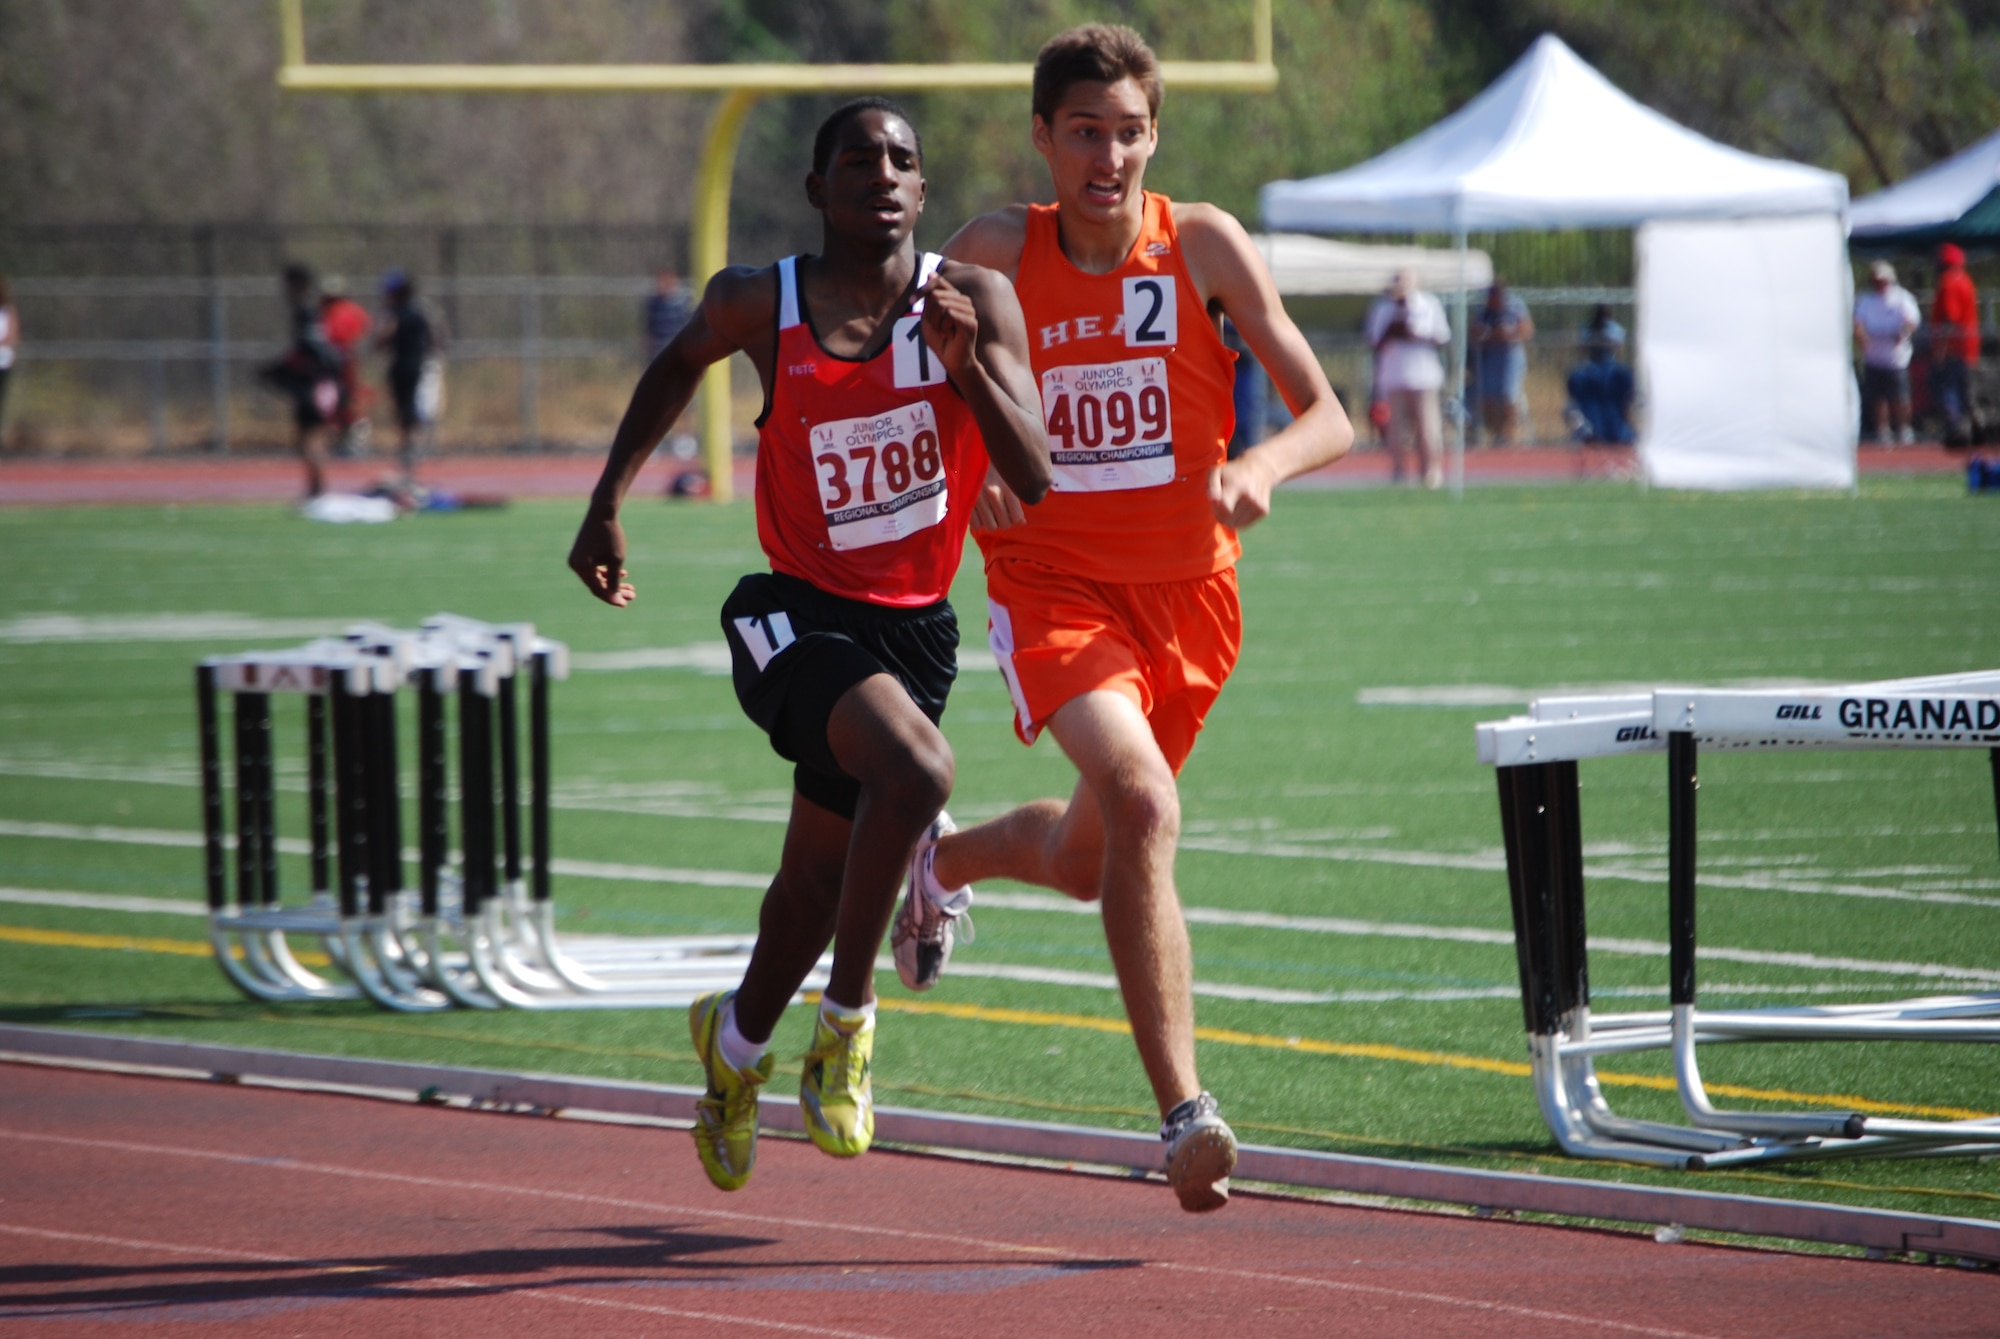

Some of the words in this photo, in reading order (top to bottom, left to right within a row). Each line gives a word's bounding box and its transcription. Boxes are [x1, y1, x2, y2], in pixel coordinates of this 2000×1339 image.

[1134, 280, 1167, 342] 2
[905, 319, 931, 382] 1
[1074, 376, 1133, 392] OLYMPICS
[1080, 366, 1125, 380] JUNIOR
[851, 416, 894, 435] JUNIOR
[1048, 385, 1168, 449] 4099
[845, 425, 905, 447] OLYMPICS
[1056, 452, 1099, 463] REGIONAL
[1100, 444, 1165, 461] CHAMPIONSHIP
[816, 429, 940, 510] 3788
[833, 505, 881, 523] REGIONAL
[881, 482, 941, 513] CHAMPIONSHIP
[749, 613, 780, 652] 1
[1775, 704, 1823, 720] GILL
[1838, 698, 2000, 731] GRANAD
